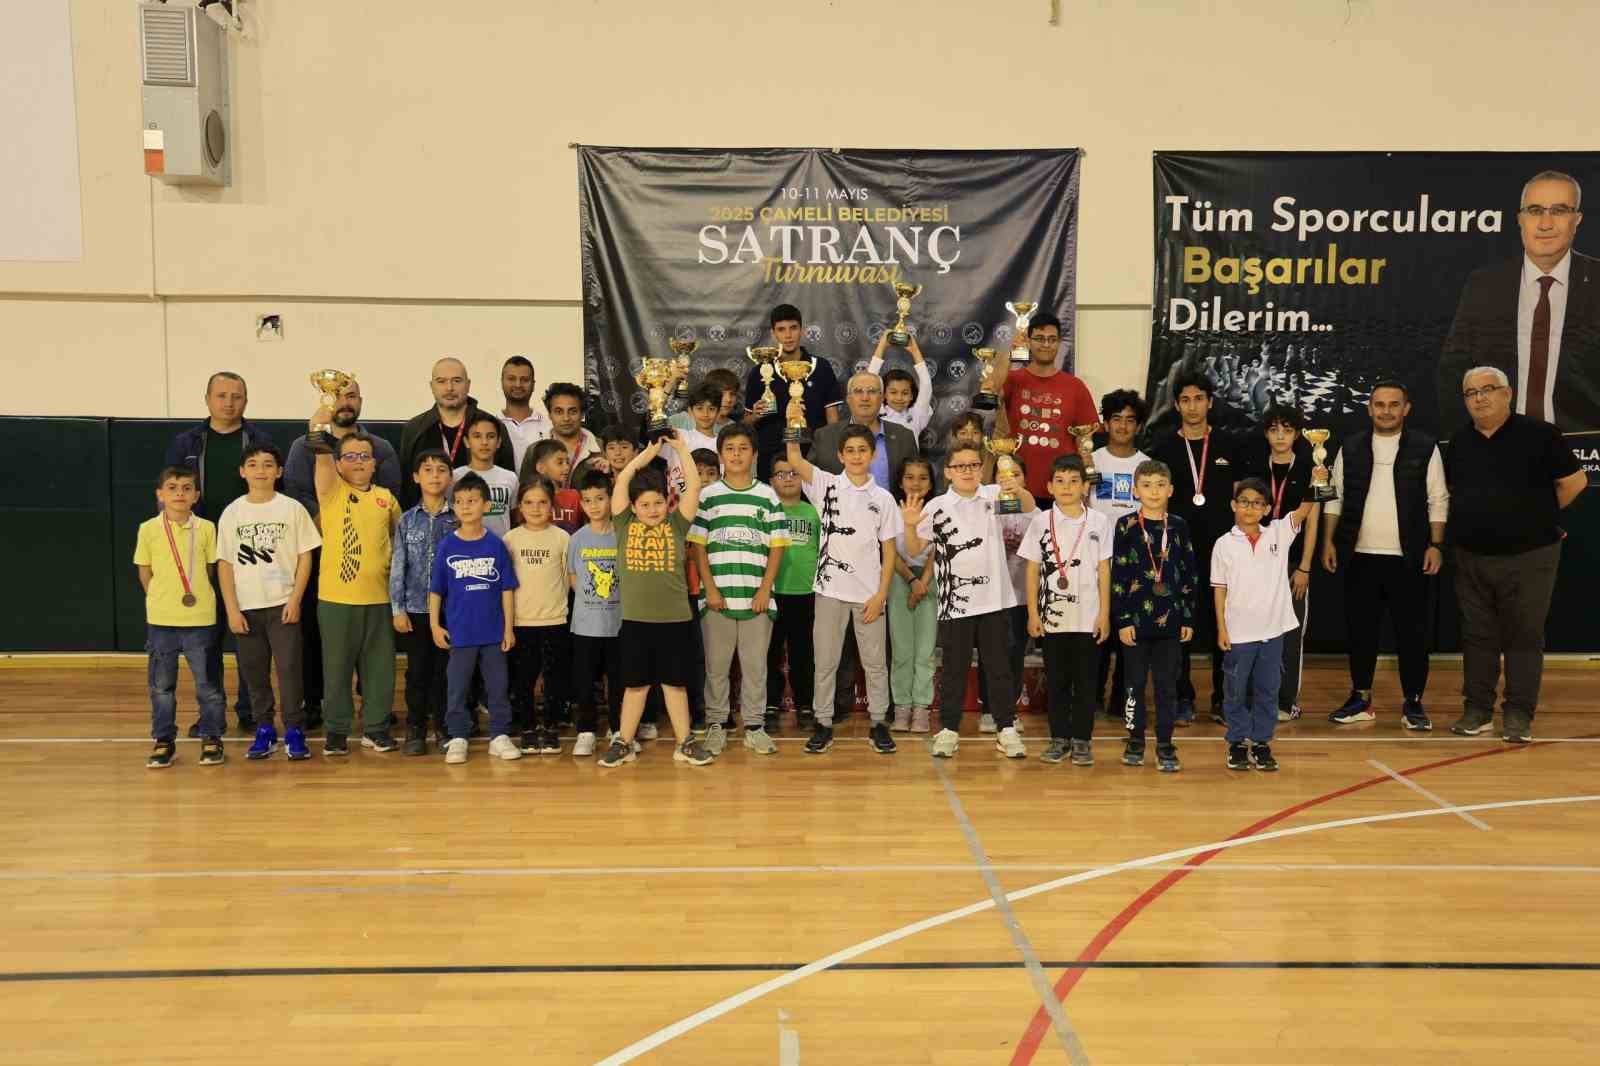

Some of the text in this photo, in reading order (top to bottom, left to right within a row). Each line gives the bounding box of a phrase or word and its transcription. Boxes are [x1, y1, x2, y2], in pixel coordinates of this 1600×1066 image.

[781, 188, 869, 200] 10-11 MAYIS
[711, 203, 949, 225] 2025 ÇAMELİ BELEDİYESİ
[1165, 194, 1503, 241] Tüm Sporculara
[698, 225, 961, 274] SATRANÇ
[762, 256, 900, 285] Turnuvası
[1183, 243, 1387, 295] Başarılar
[1169, 295, 1333, 332] Dilerim...
[520, 548, 550, 558] BELIEVE
[627, 537, 675, 550] BRAVE
[527, 557, 543, 565] LOVE
[626, 550, 675, 560] BRAVE
